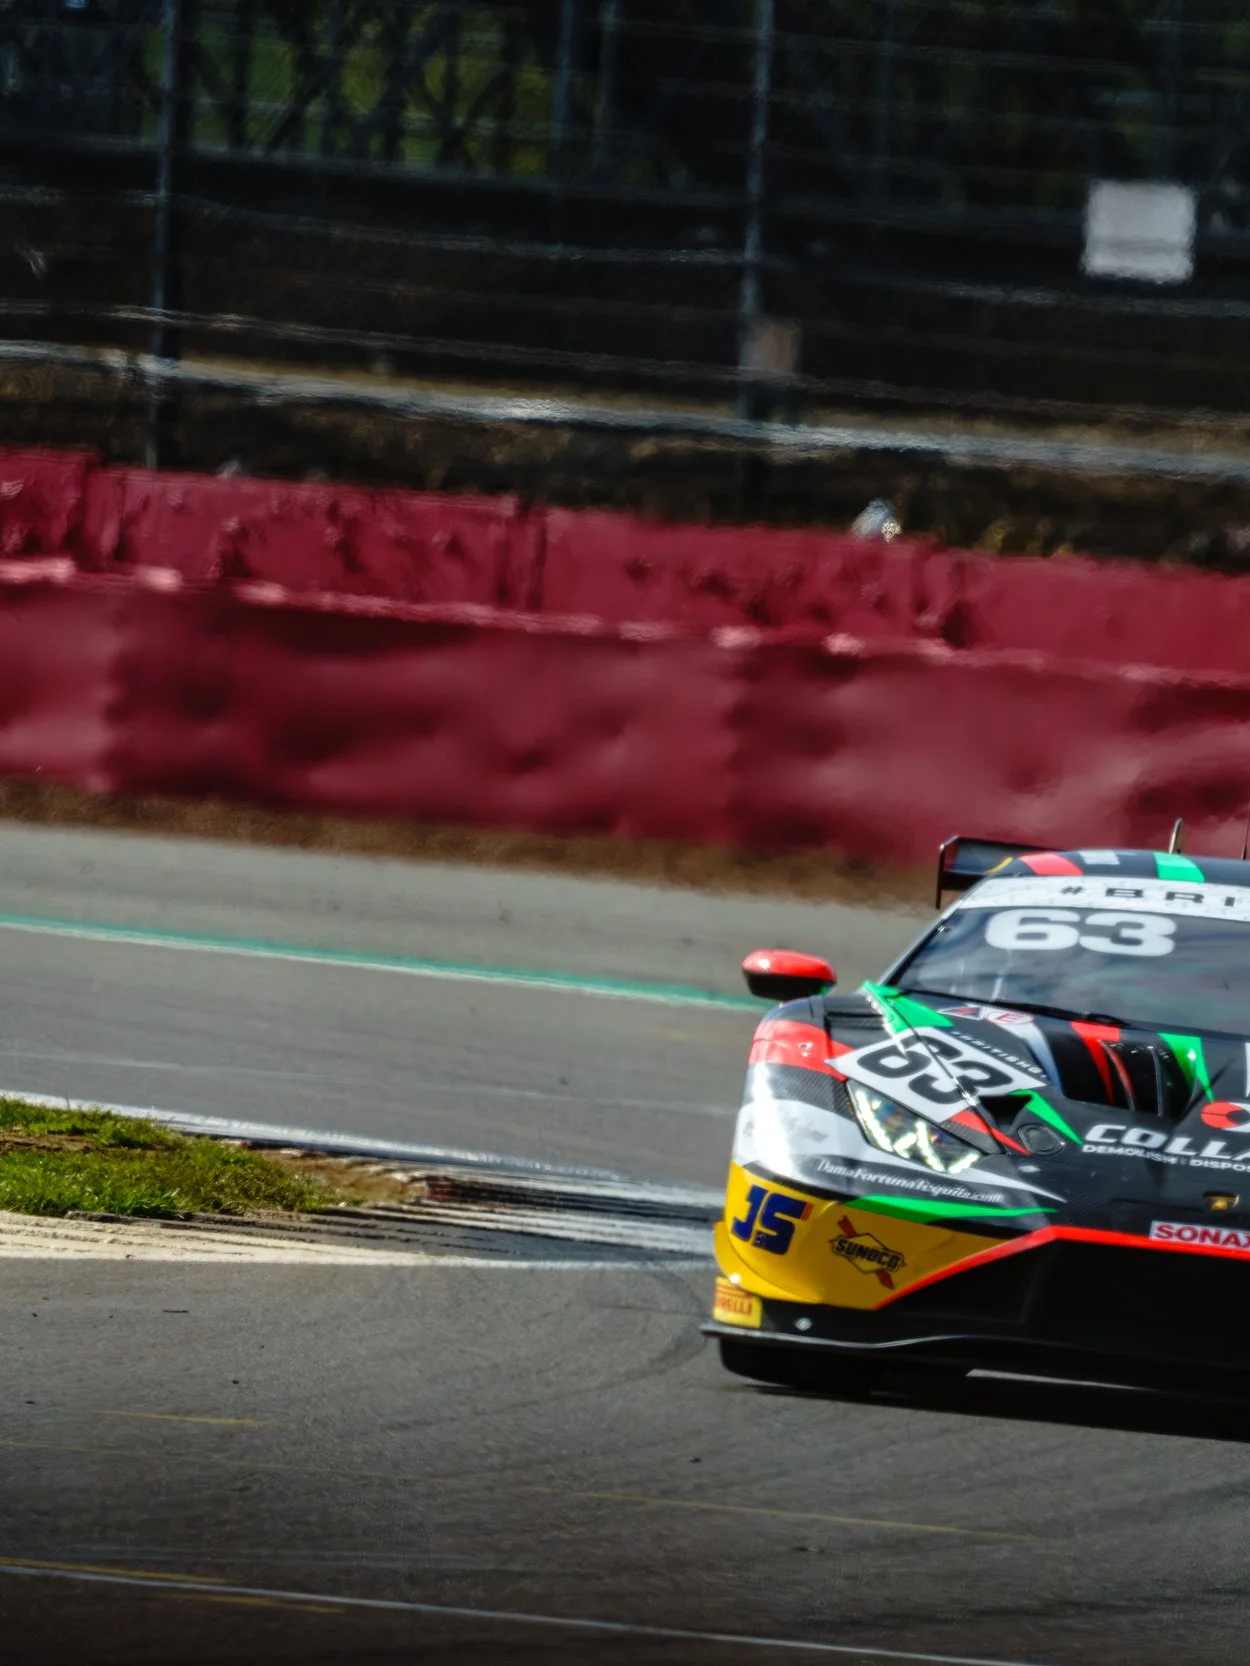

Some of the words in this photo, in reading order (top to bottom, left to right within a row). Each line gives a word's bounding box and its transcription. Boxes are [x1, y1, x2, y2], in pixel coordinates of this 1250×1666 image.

[984, 907, 1176, 956] 63
[857, 1035, 1013, 1105] 63
[1082, 1143, 1177, 1165] DEMOLISH
[732, 1184, 809, 1256] JS
[835, 1237, 901, 1269] SUNOCO
